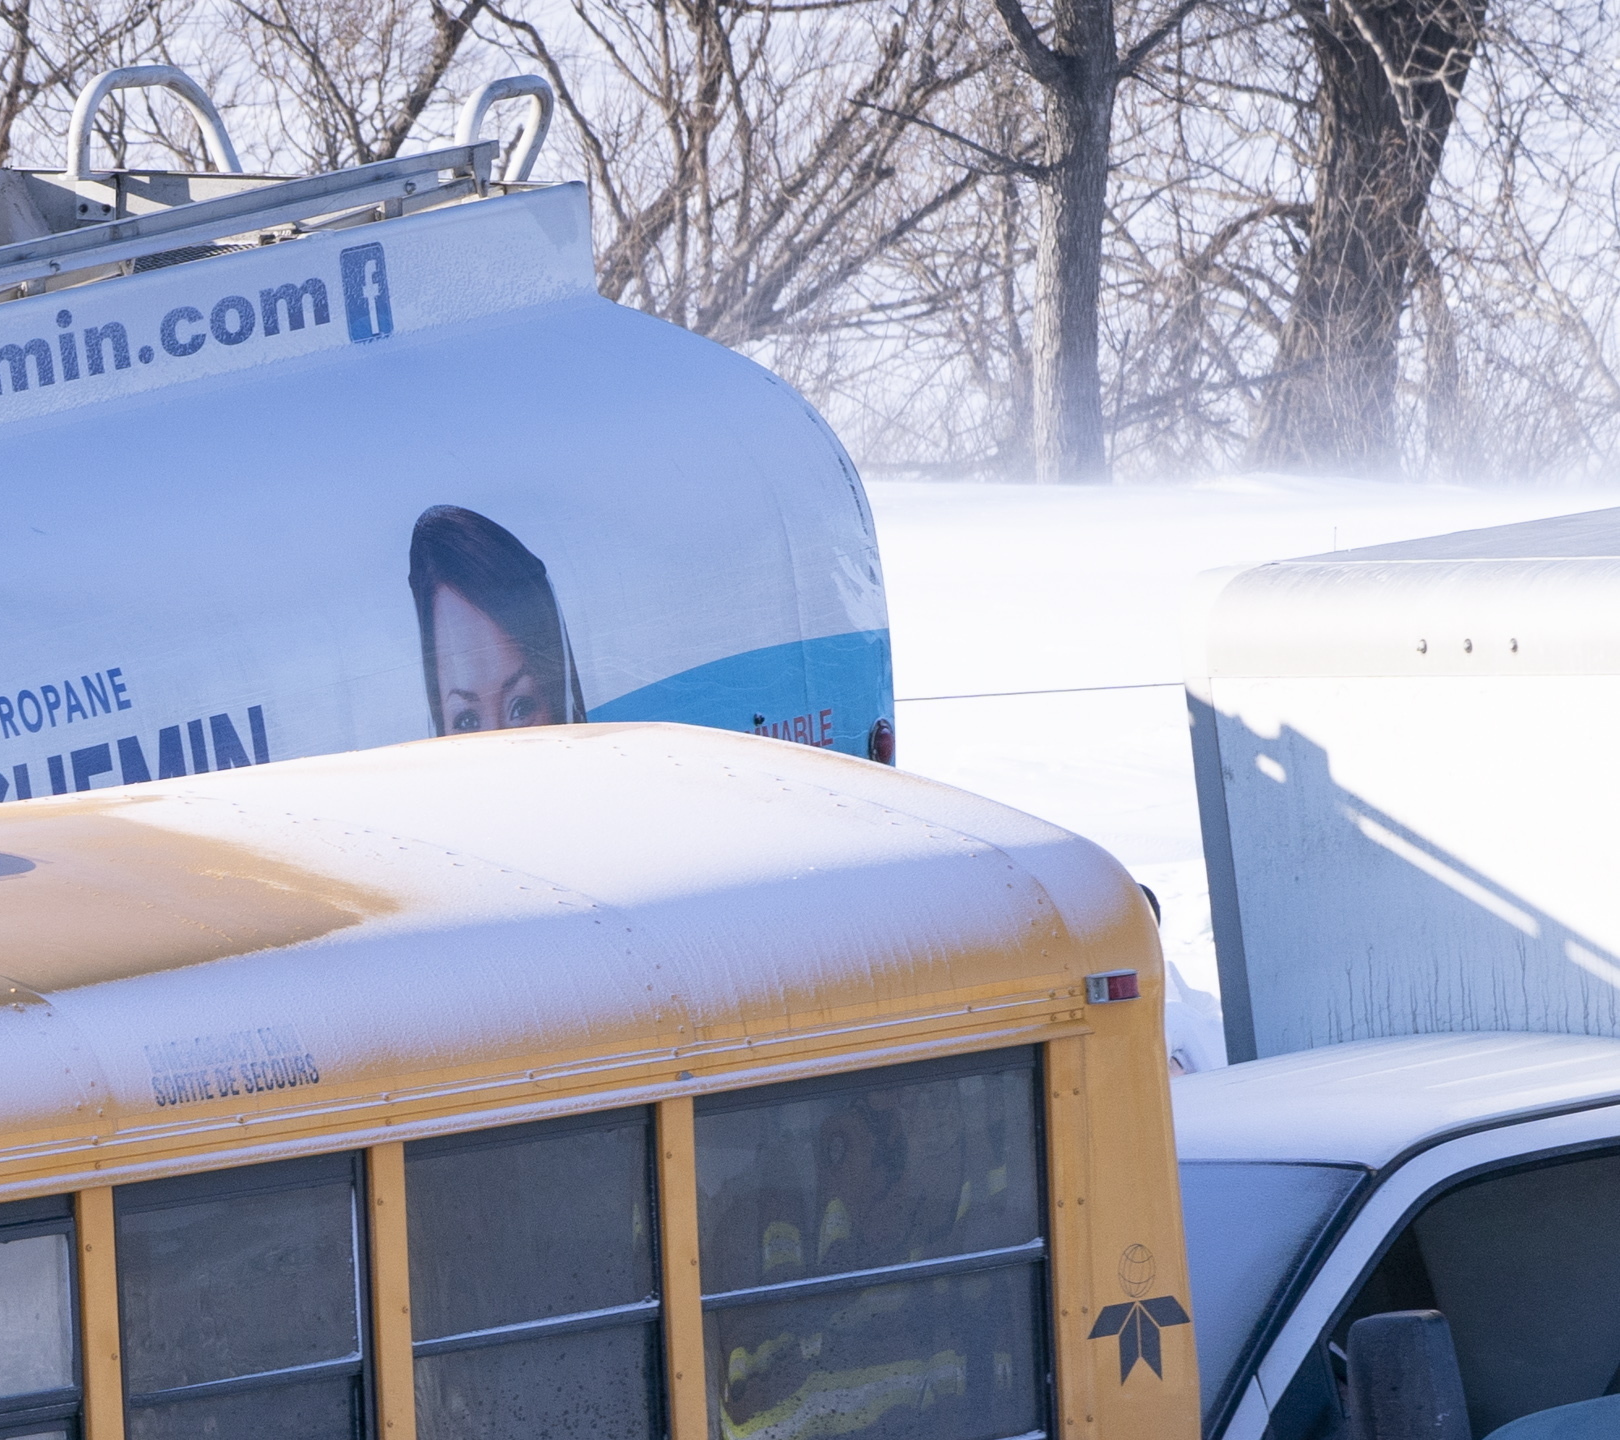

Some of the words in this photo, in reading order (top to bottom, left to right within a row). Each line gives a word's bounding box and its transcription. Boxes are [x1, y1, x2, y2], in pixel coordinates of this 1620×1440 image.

[743, 708, 834, 747] ABLE
[151, 1070, 214, 1107] SORTIE
[215, 1066, 240, 1097] DE
[240, 1053, 320, 1094] SECOURS
